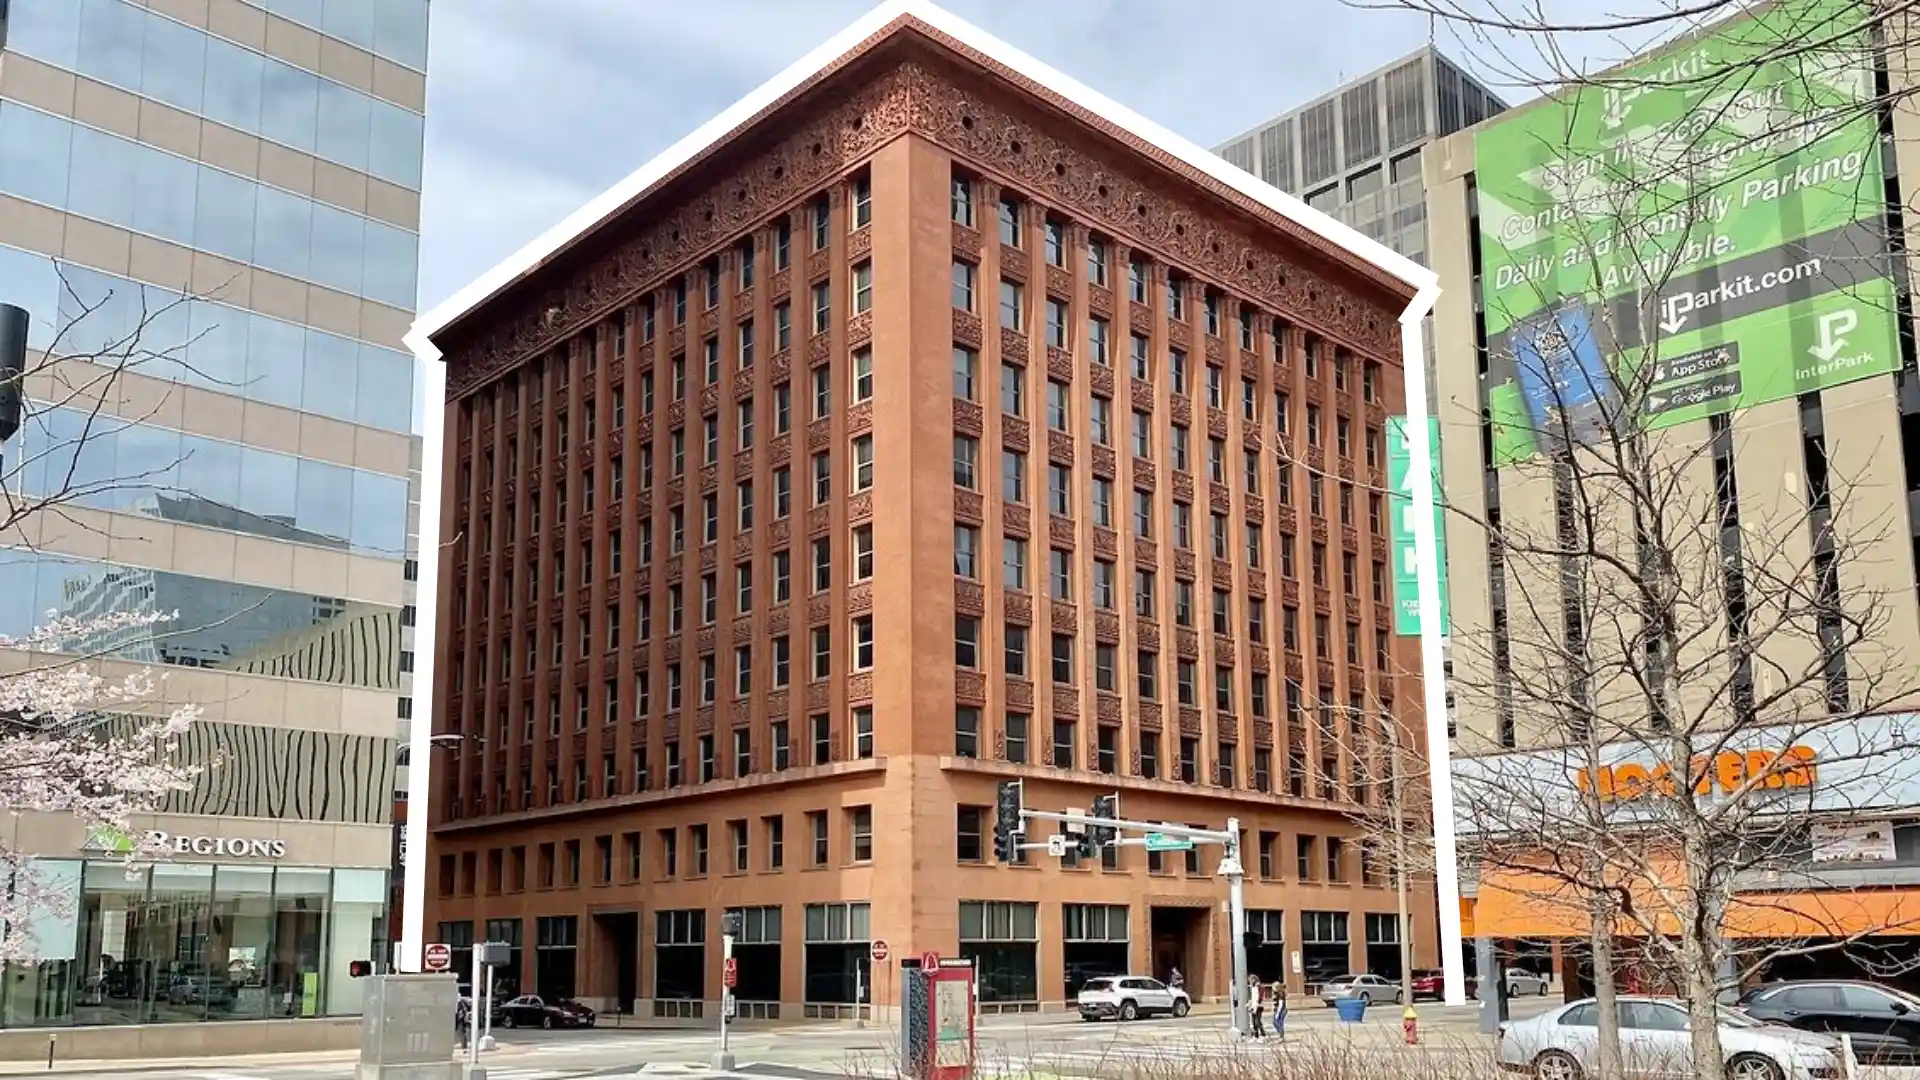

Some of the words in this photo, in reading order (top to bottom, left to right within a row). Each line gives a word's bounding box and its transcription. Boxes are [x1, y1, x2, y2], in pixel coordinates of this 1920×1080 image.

[1494, 254, 1555, 291] Daily
[1741, 149, 1862, 208] Parking
[1671, 364, 1697, 378] App
[1795, 351, 1875, 381] InterPark
[1712, 383, 1737, 396] Play
